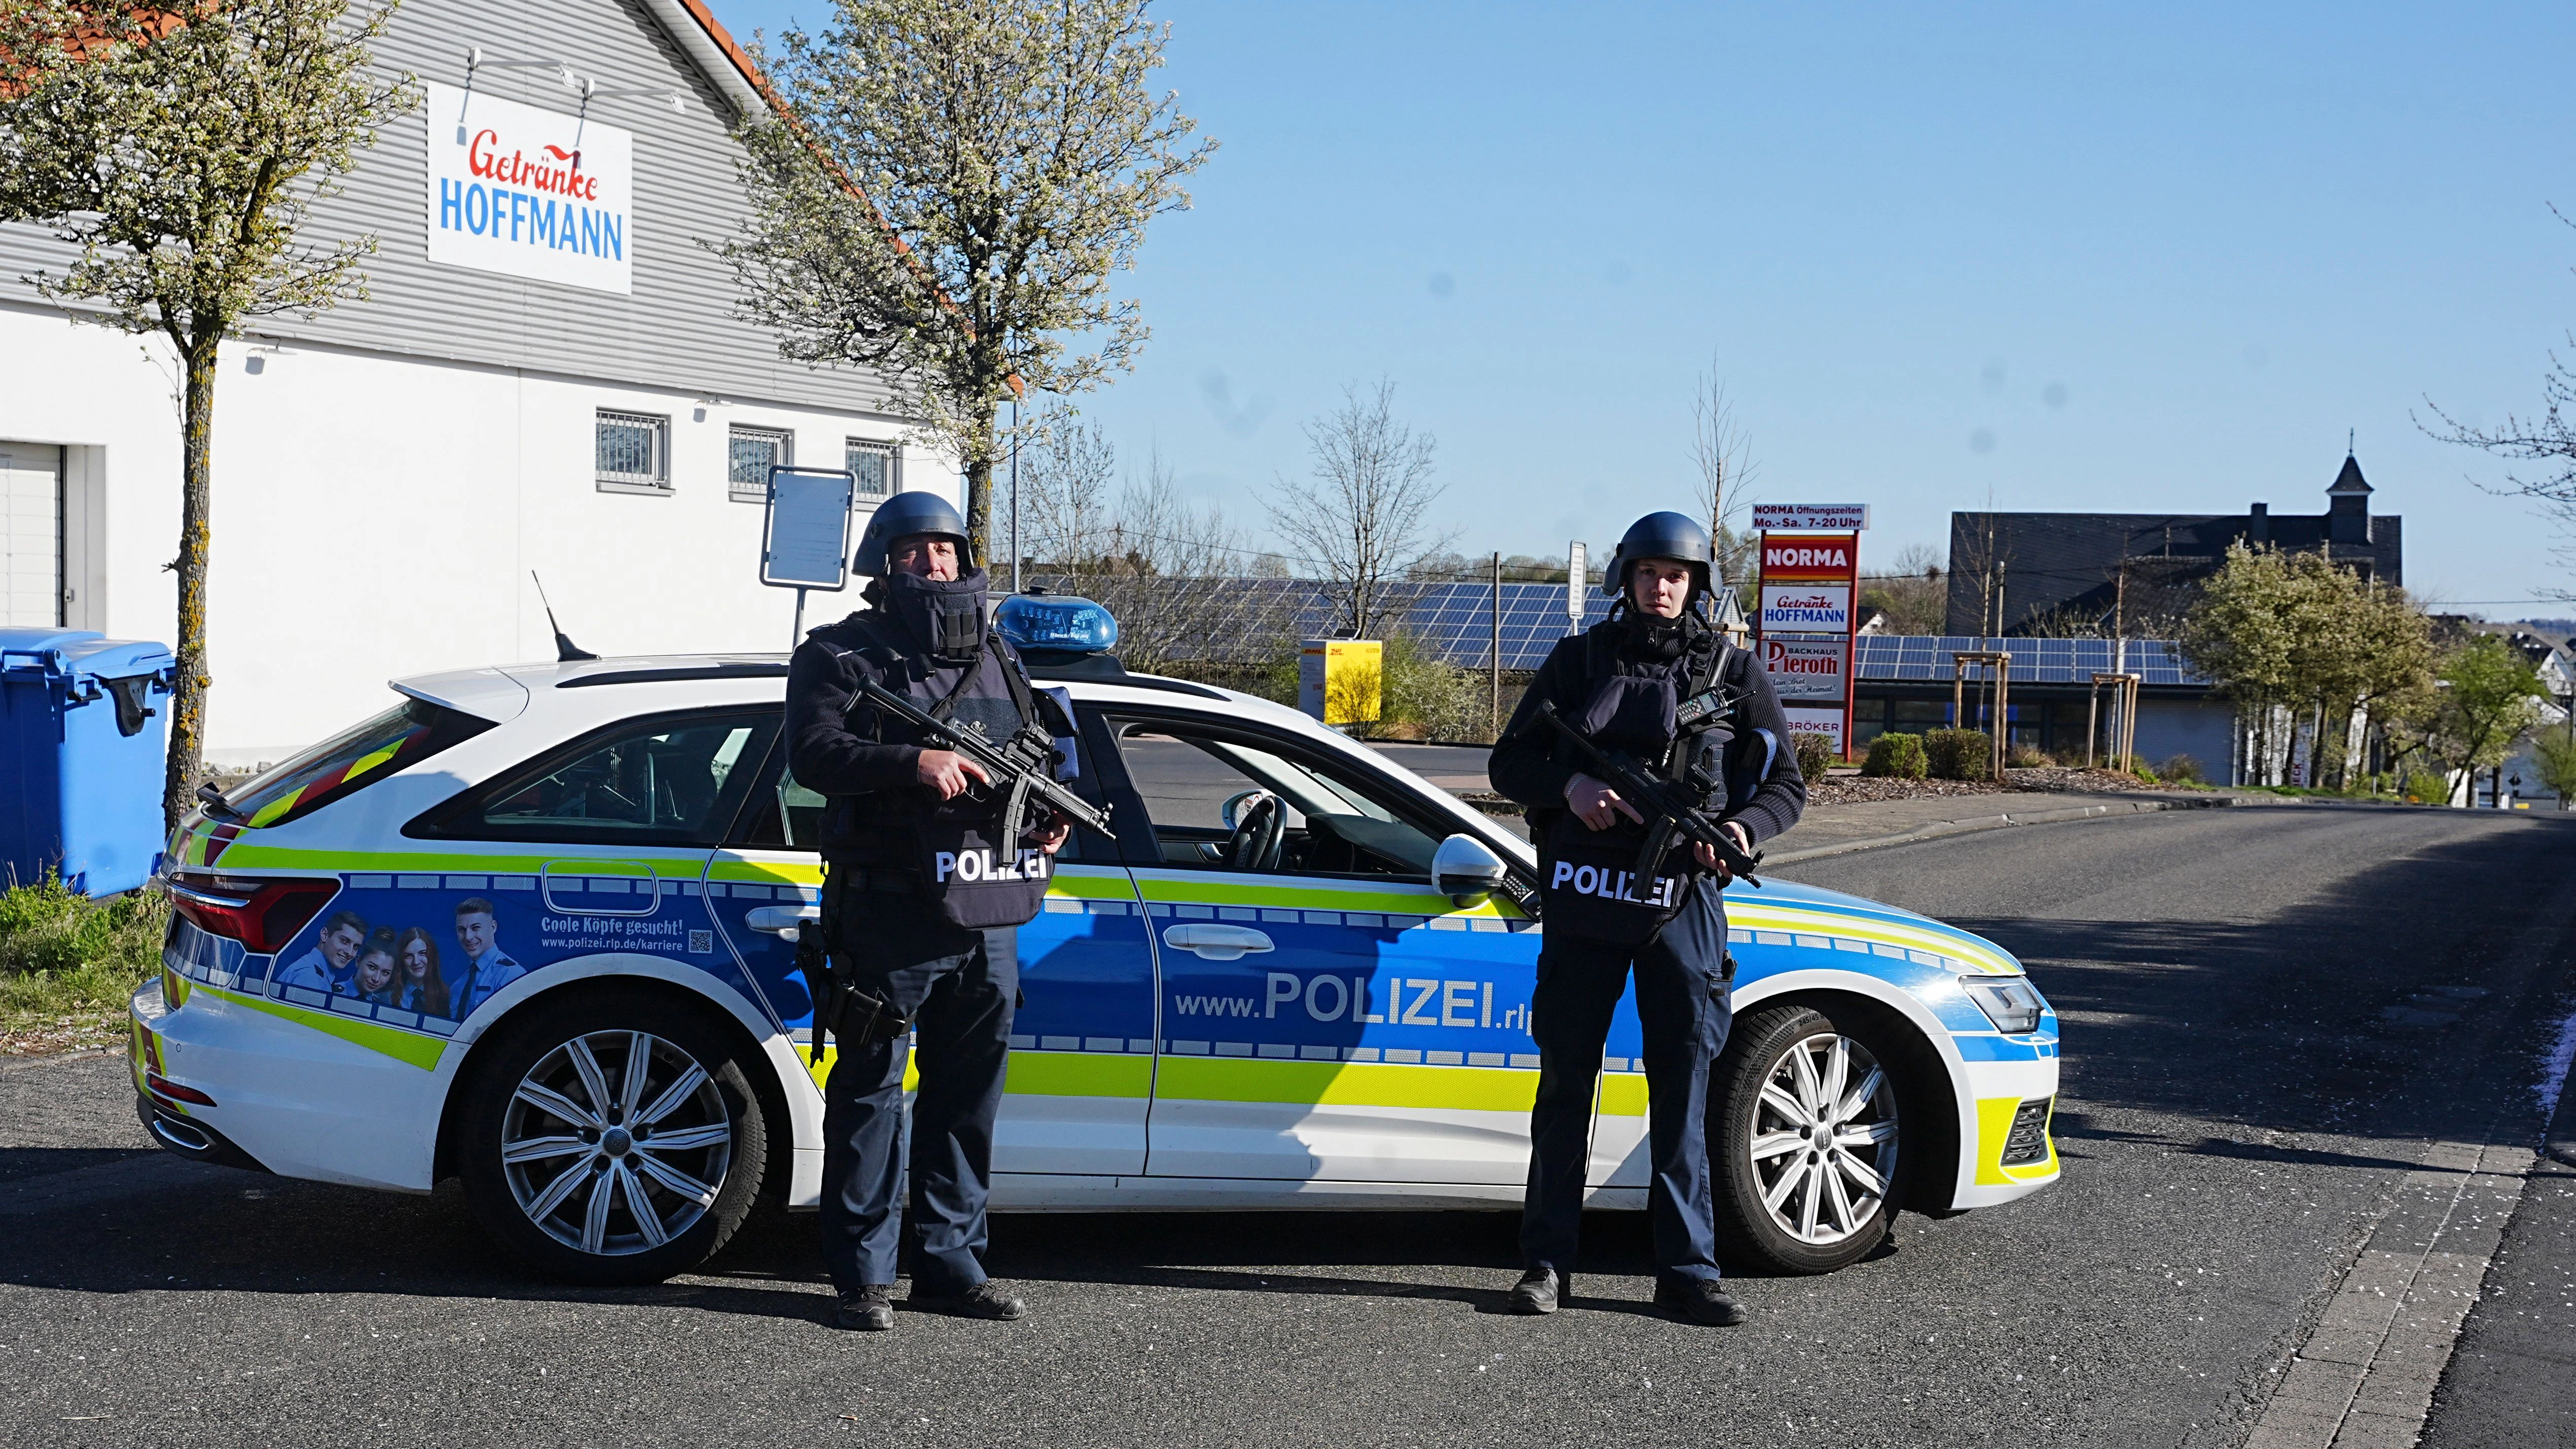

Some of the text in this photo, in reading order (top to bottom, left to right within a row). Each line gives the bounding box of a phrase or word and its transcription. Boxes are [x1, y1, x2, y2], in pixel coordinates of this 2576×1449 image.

[469, 129, 598, 201] Getränke
[441, 177, 622, 262] HOFFMANN
[1754, 505, 1862, 516] NORMA Öffnungszeiten
[1808, 518, 1837, 527] 7-20
[1839, 518, 1862, 527] Uhr
[1766, 549, 1847, 567] NORMA
[1777, 595, 1833, 609] Getränke
[1765, 608, 1844, 622] HOFFMANN
[1767, 641, 1838, 675] Pieroth
[1788, 647, 1838, 656] BACKHAUS
[541, 917, 683, 936] Coole Köpfe gesucht!
[541, 937, 683, 951] www.polizei.rlp.de/karriere
[1799, 1014, 1819, 1026] 245/45
